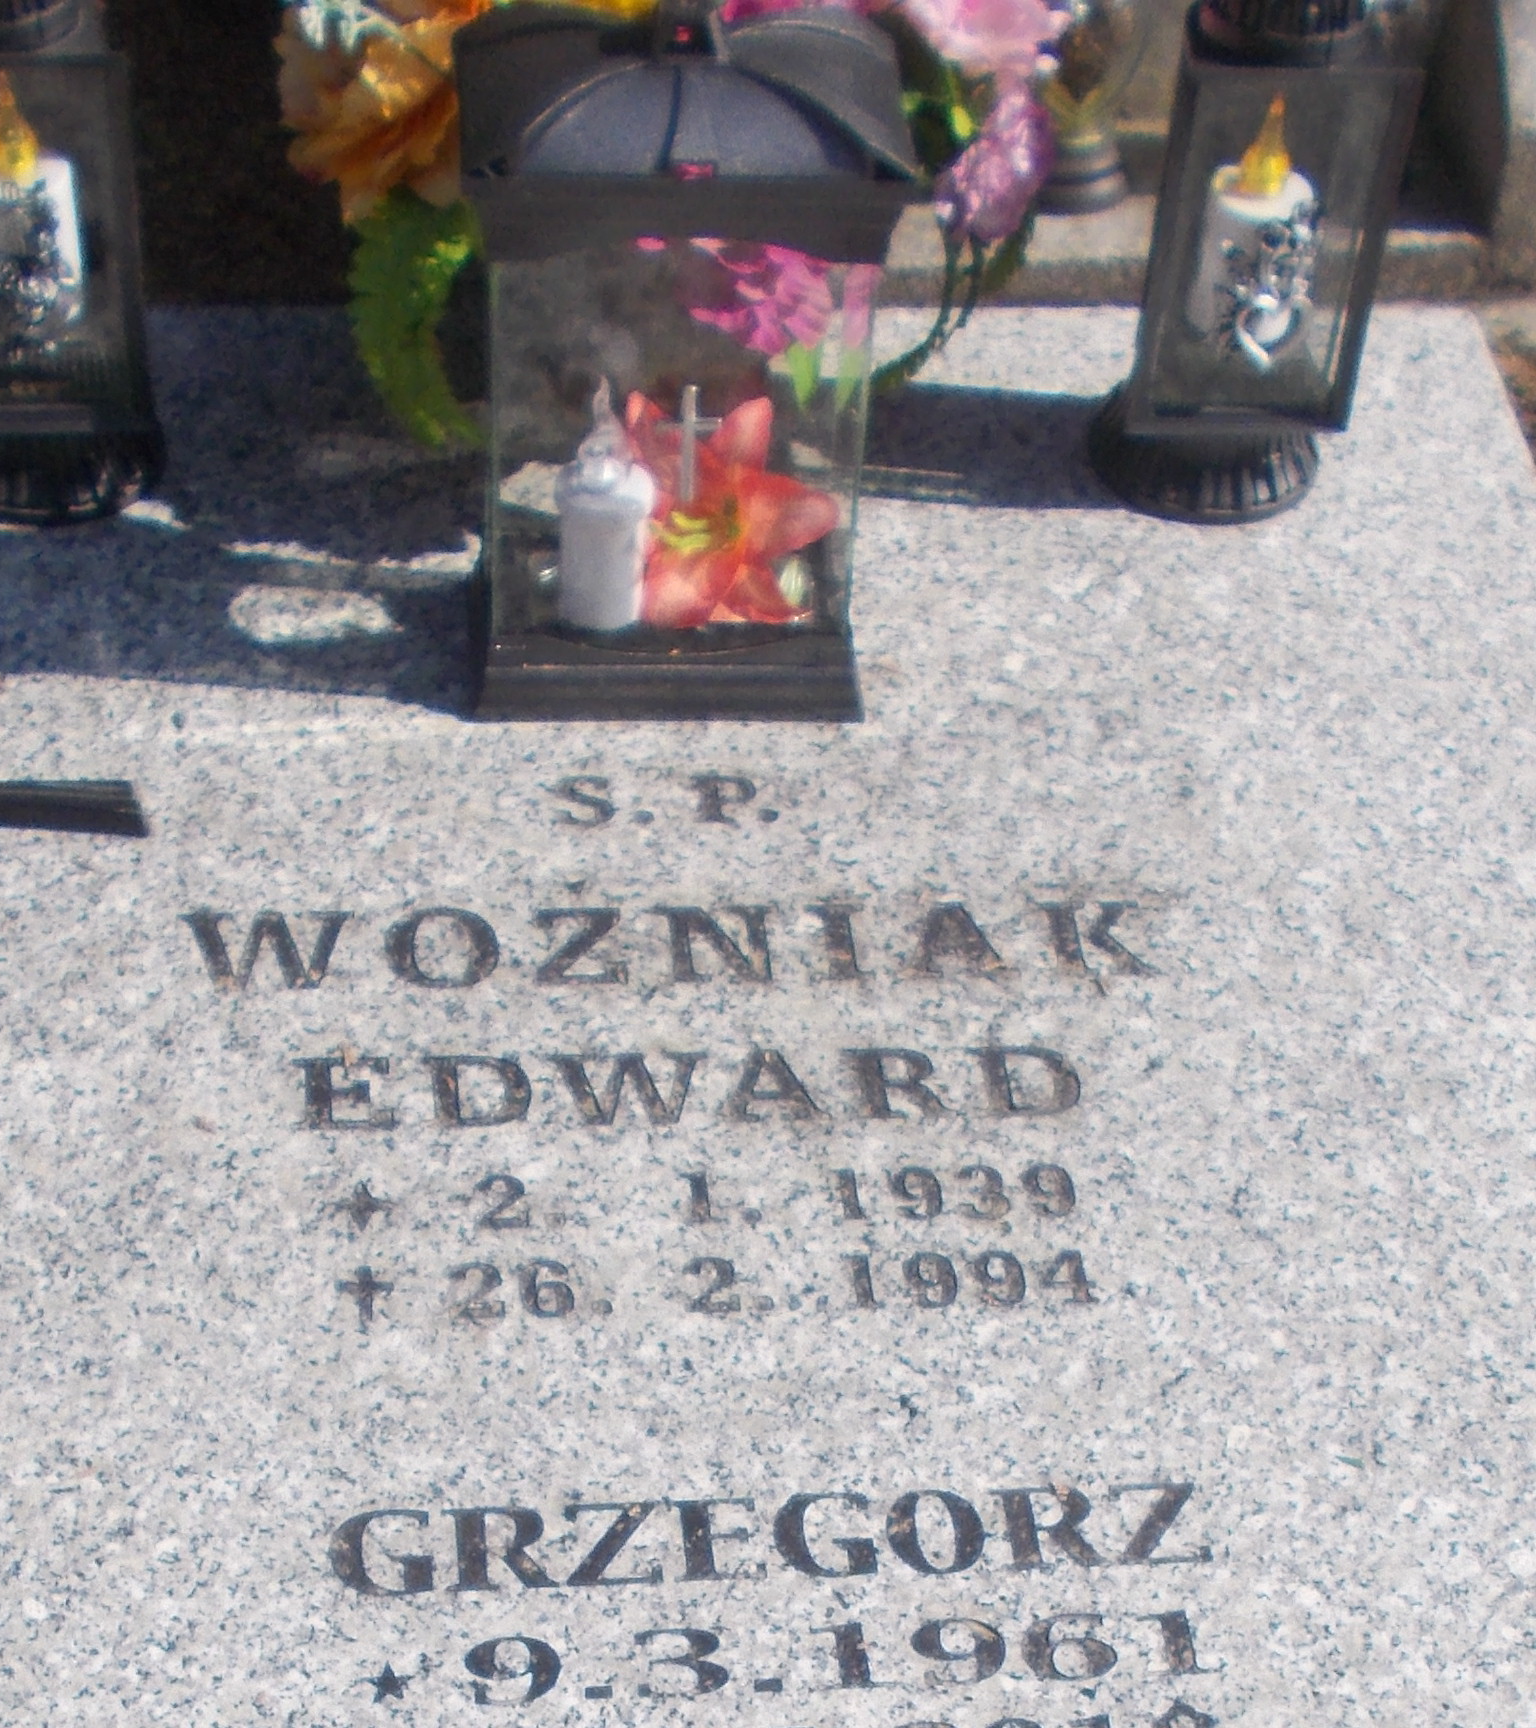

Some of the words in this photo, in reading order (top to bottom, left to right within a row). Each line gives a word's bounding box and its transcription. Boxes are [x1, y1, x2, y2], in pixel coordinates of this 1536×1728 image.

[292, 1044, 1084, 1132] EDWARD
[832, 1162, 1077, 1221] 1939
[839, 1249, 1101, 1312] 1994
[326, 1480, 1214, 1598] GRZEGORZ
[464, 1609, 1206, 1706] 9.3.1961
